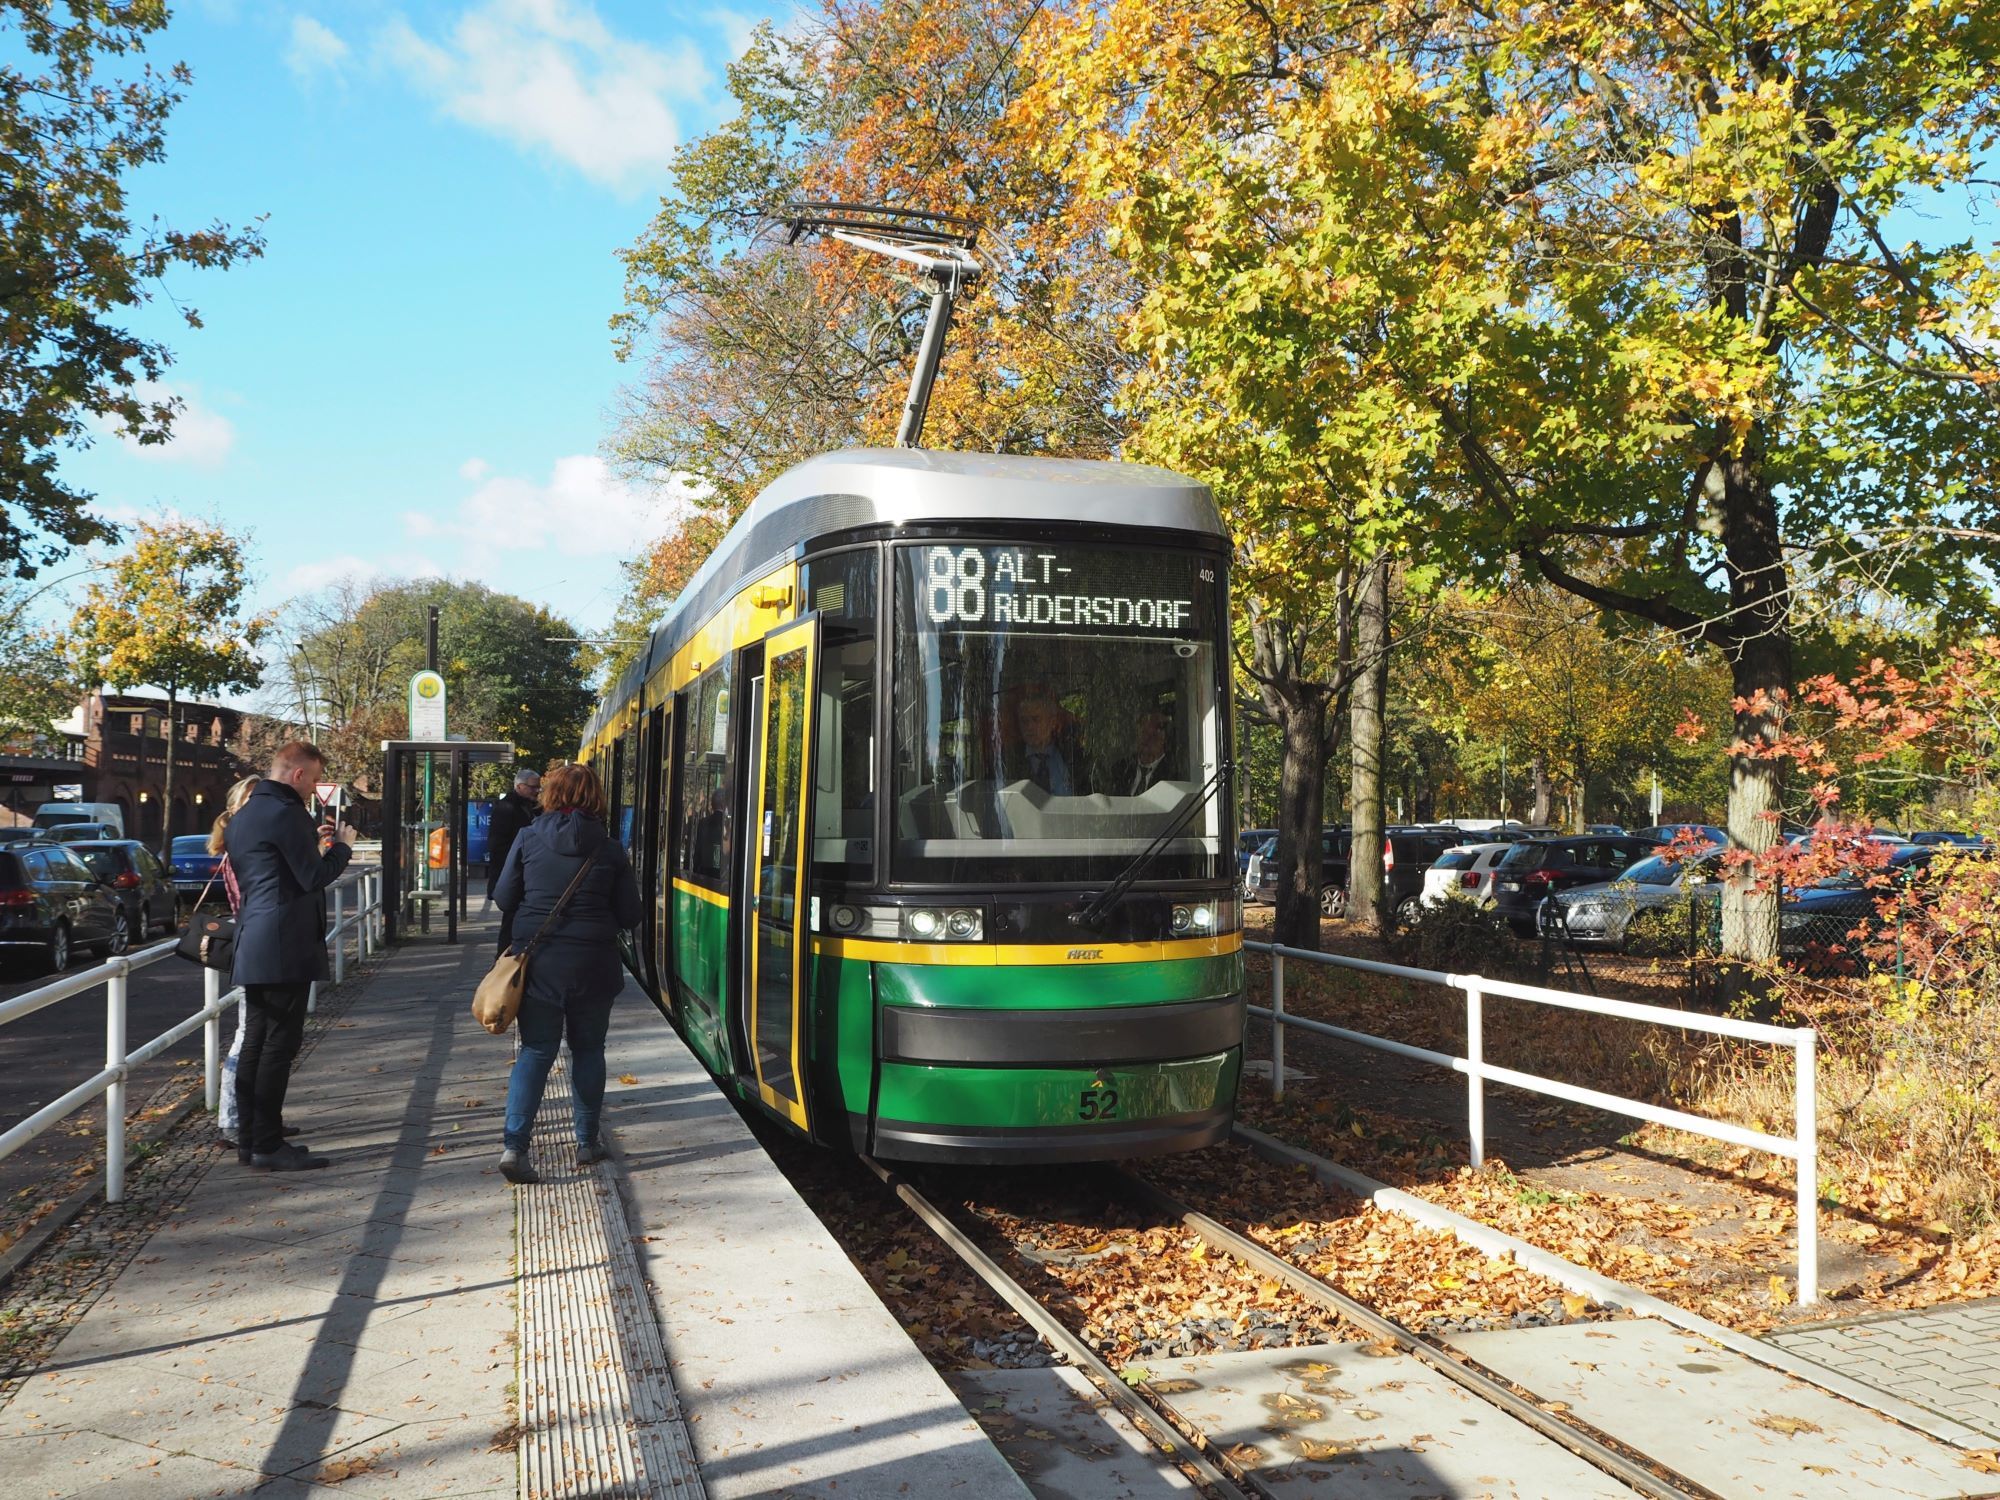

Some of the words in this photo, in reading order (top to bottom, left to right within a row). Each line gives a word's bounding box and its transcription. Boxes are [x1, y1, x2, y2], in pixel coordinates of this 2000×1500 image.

[928, 546, 985, 622] 88
[994, 552, 1072, 583] ALT-
[1200, 568, 1215, 583] 402
[994, 593, 1192, 629] RÜDERSDORF
[1078, 1089, 1119, 1121] 52
